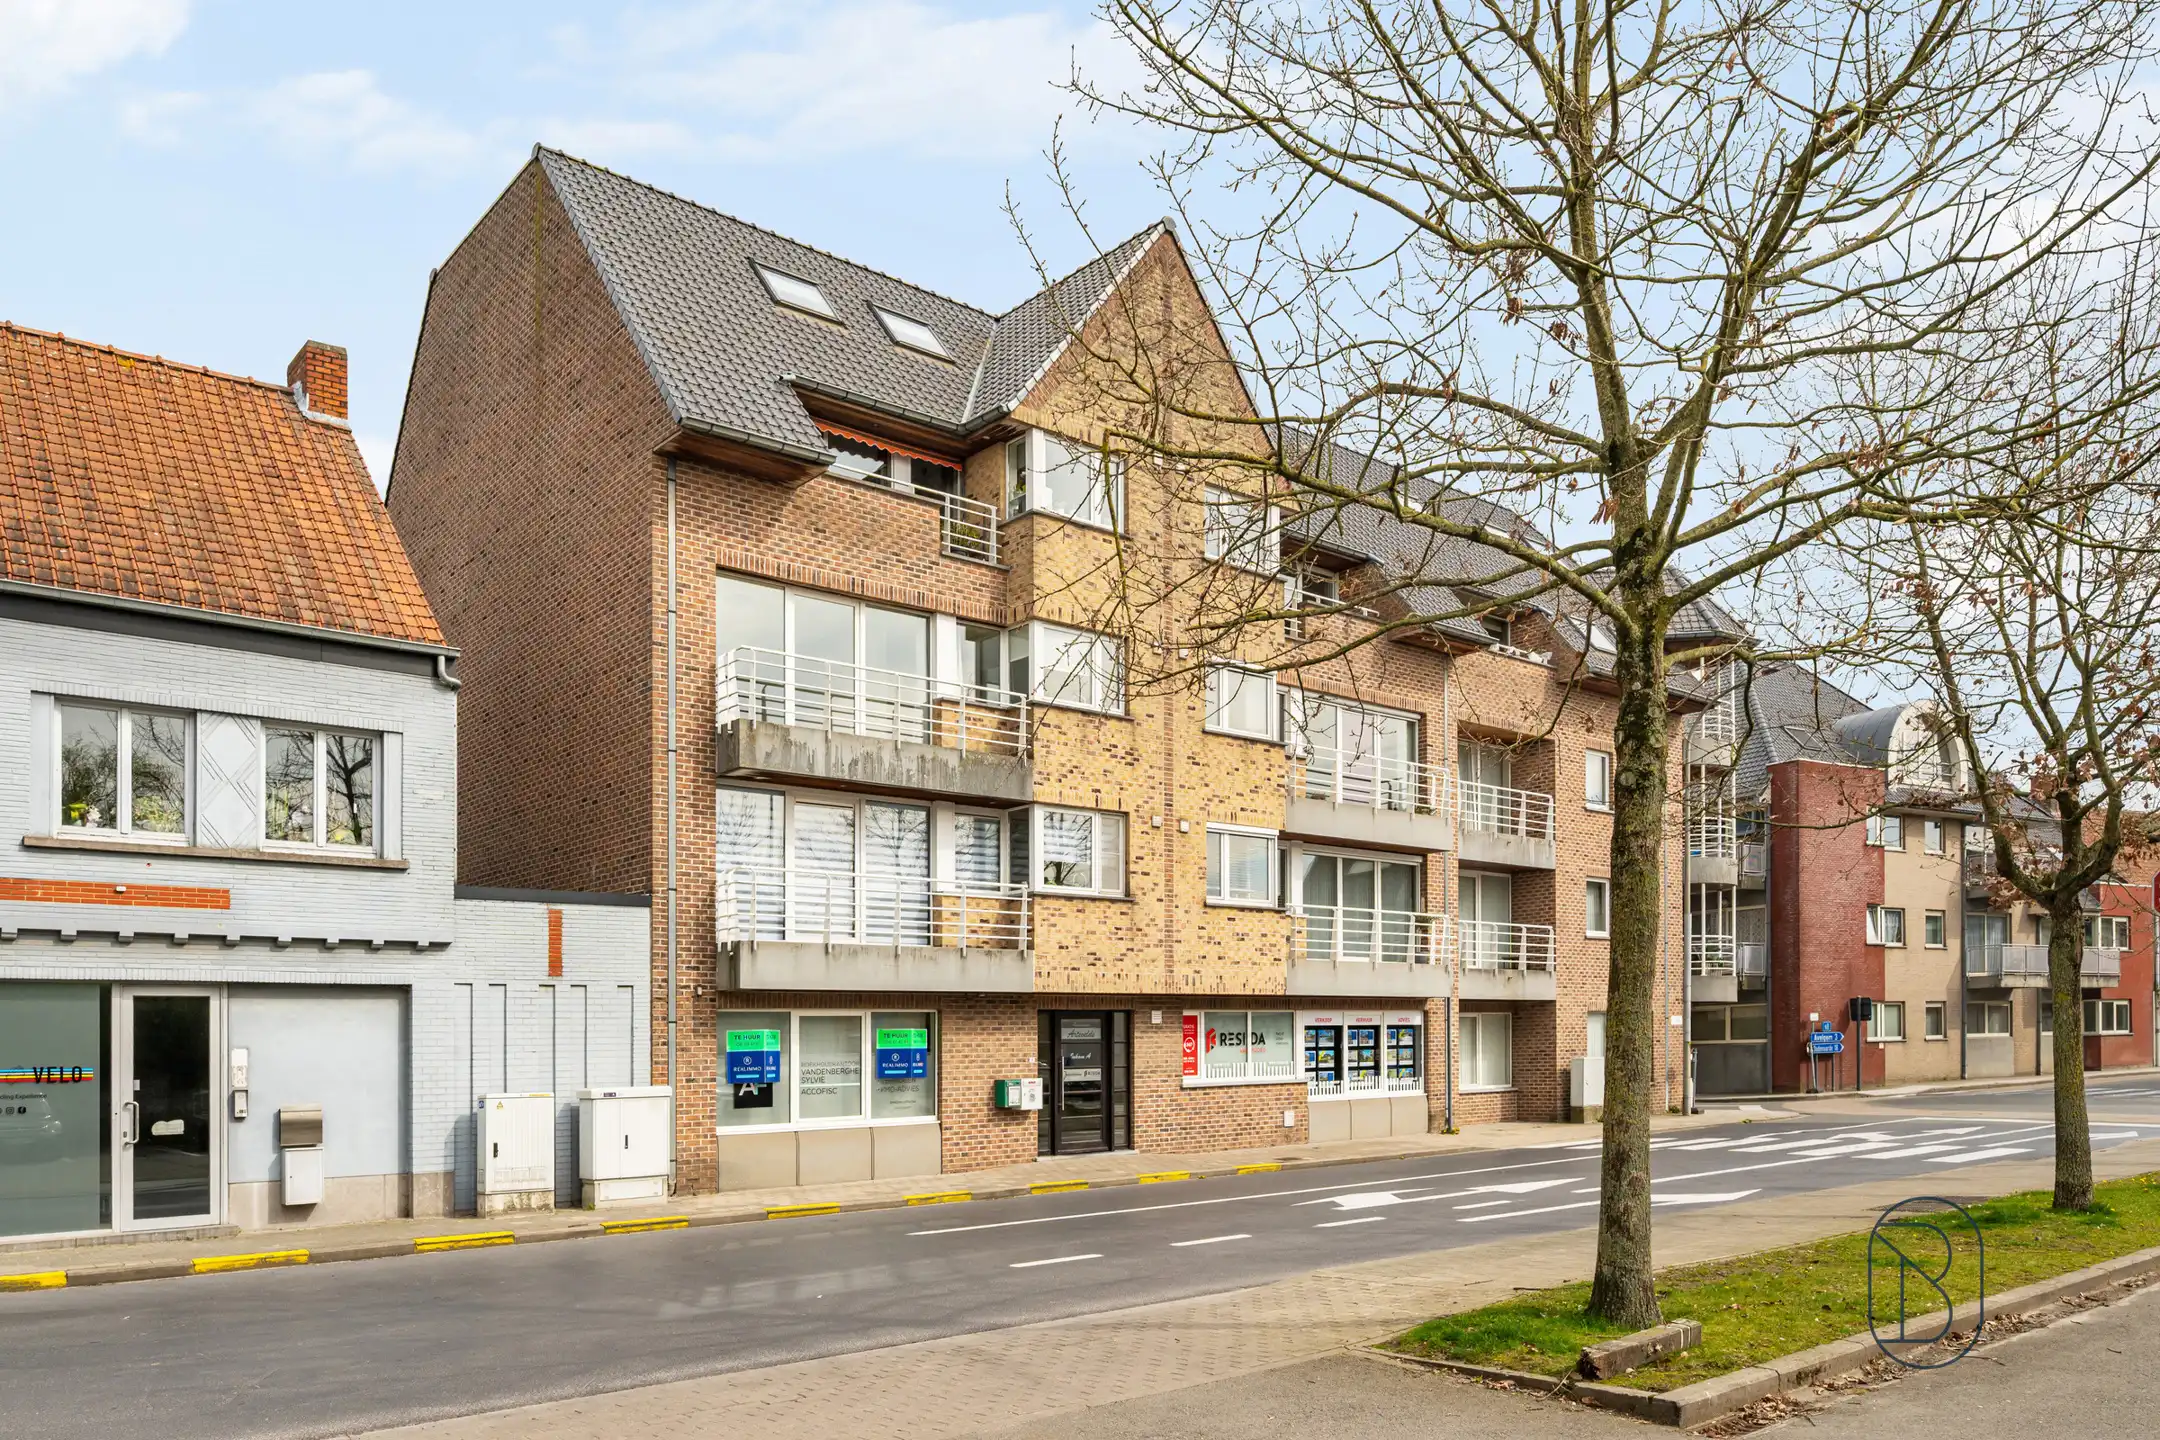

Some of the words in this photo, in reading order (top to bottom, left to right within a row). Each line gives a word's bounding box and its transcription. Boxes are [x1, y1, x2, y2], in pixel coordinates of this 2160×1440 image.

[33, 1066, 82, 1084] VELO
[801, 1067, 860, 1075] VANDENBERGHE
[801, 1076, 826, 1084] SYLVIE
[801, 1087, 838, 1095] ACCOFISC
